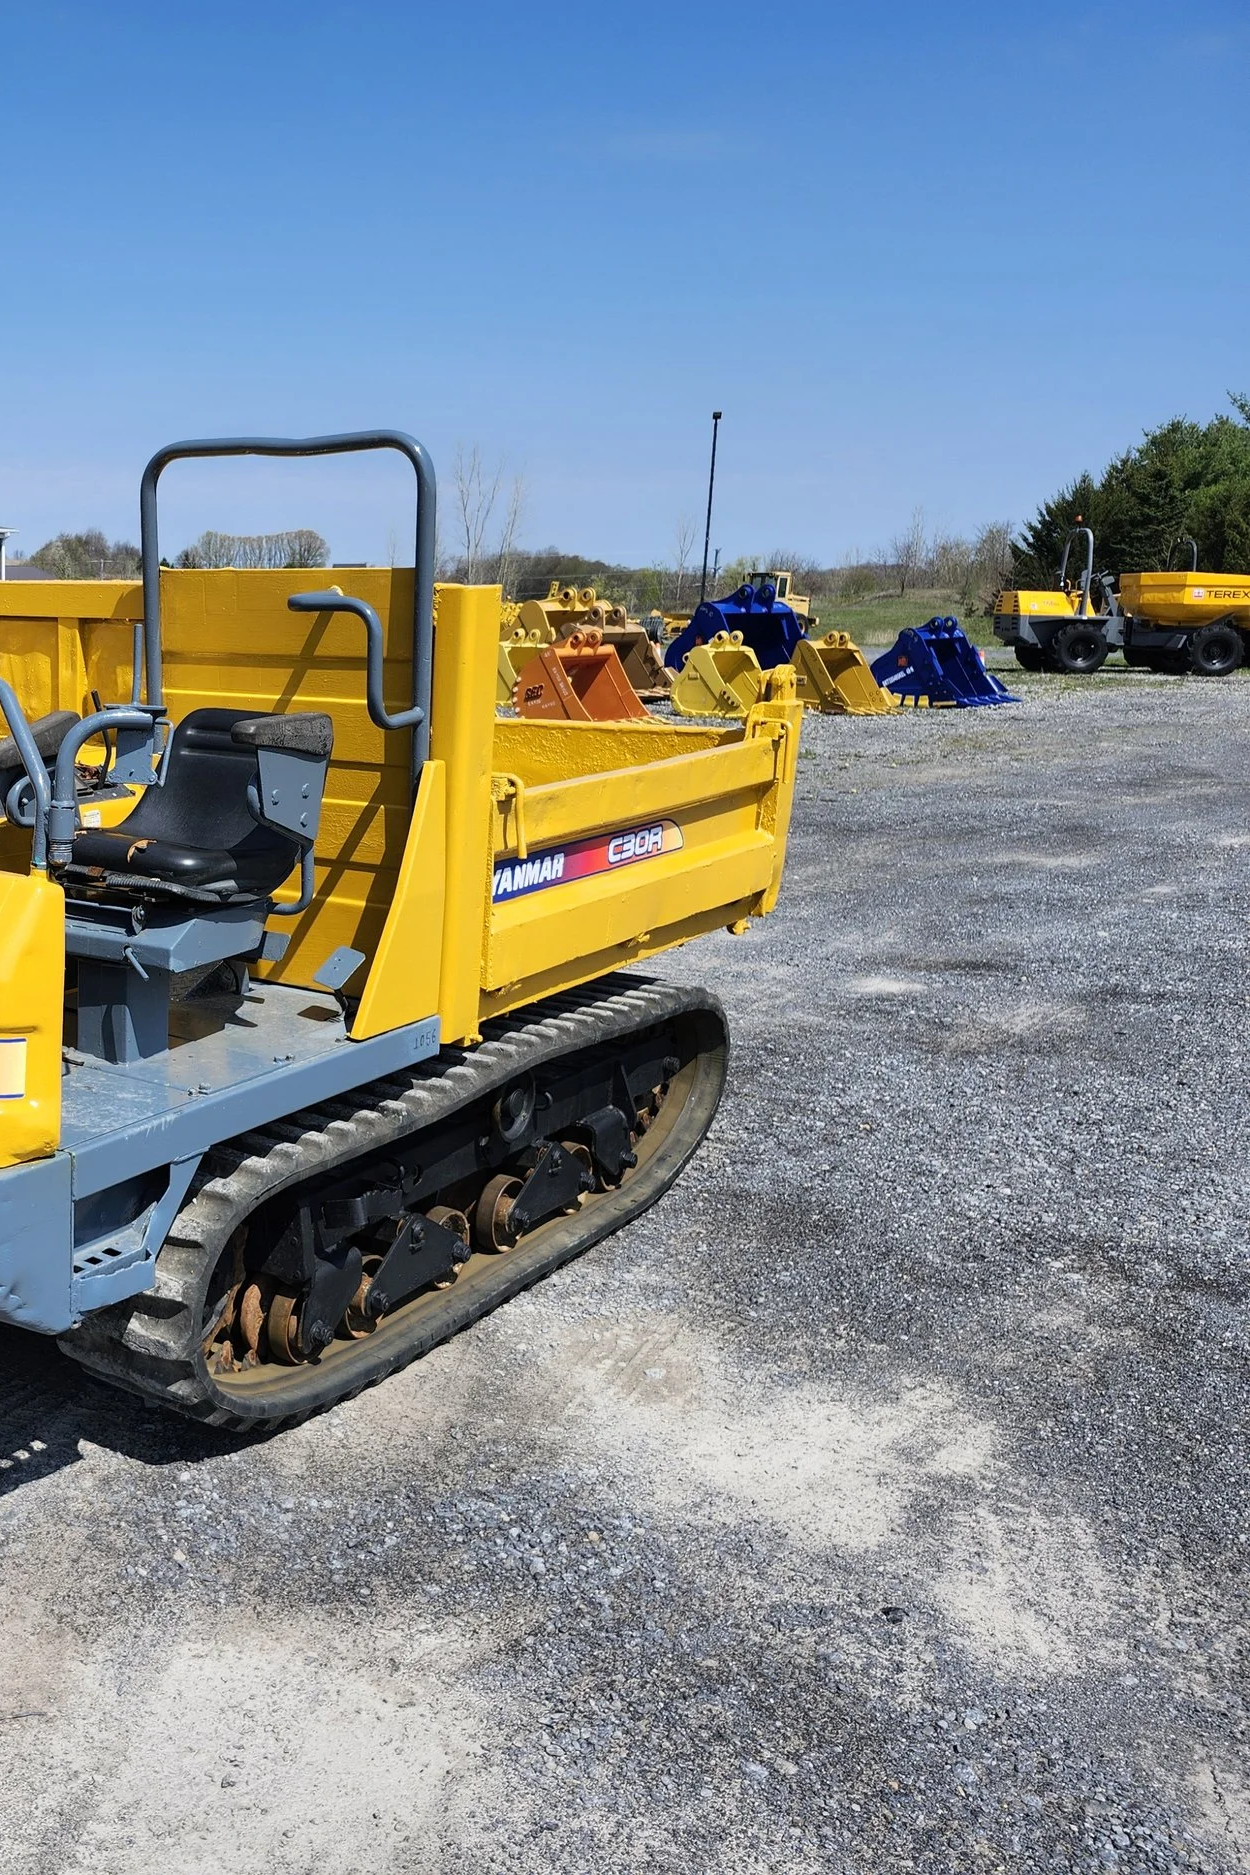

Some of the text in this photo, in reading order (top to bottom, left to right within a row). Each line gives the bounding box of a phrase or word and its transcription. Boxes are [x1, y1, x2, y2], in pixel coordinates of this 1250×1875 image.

[1206, 589, 1250, 599] TEREX
[492, 824, 663, 897] YANMAR C30R
[413, 1028, 437, 1050] 1056
